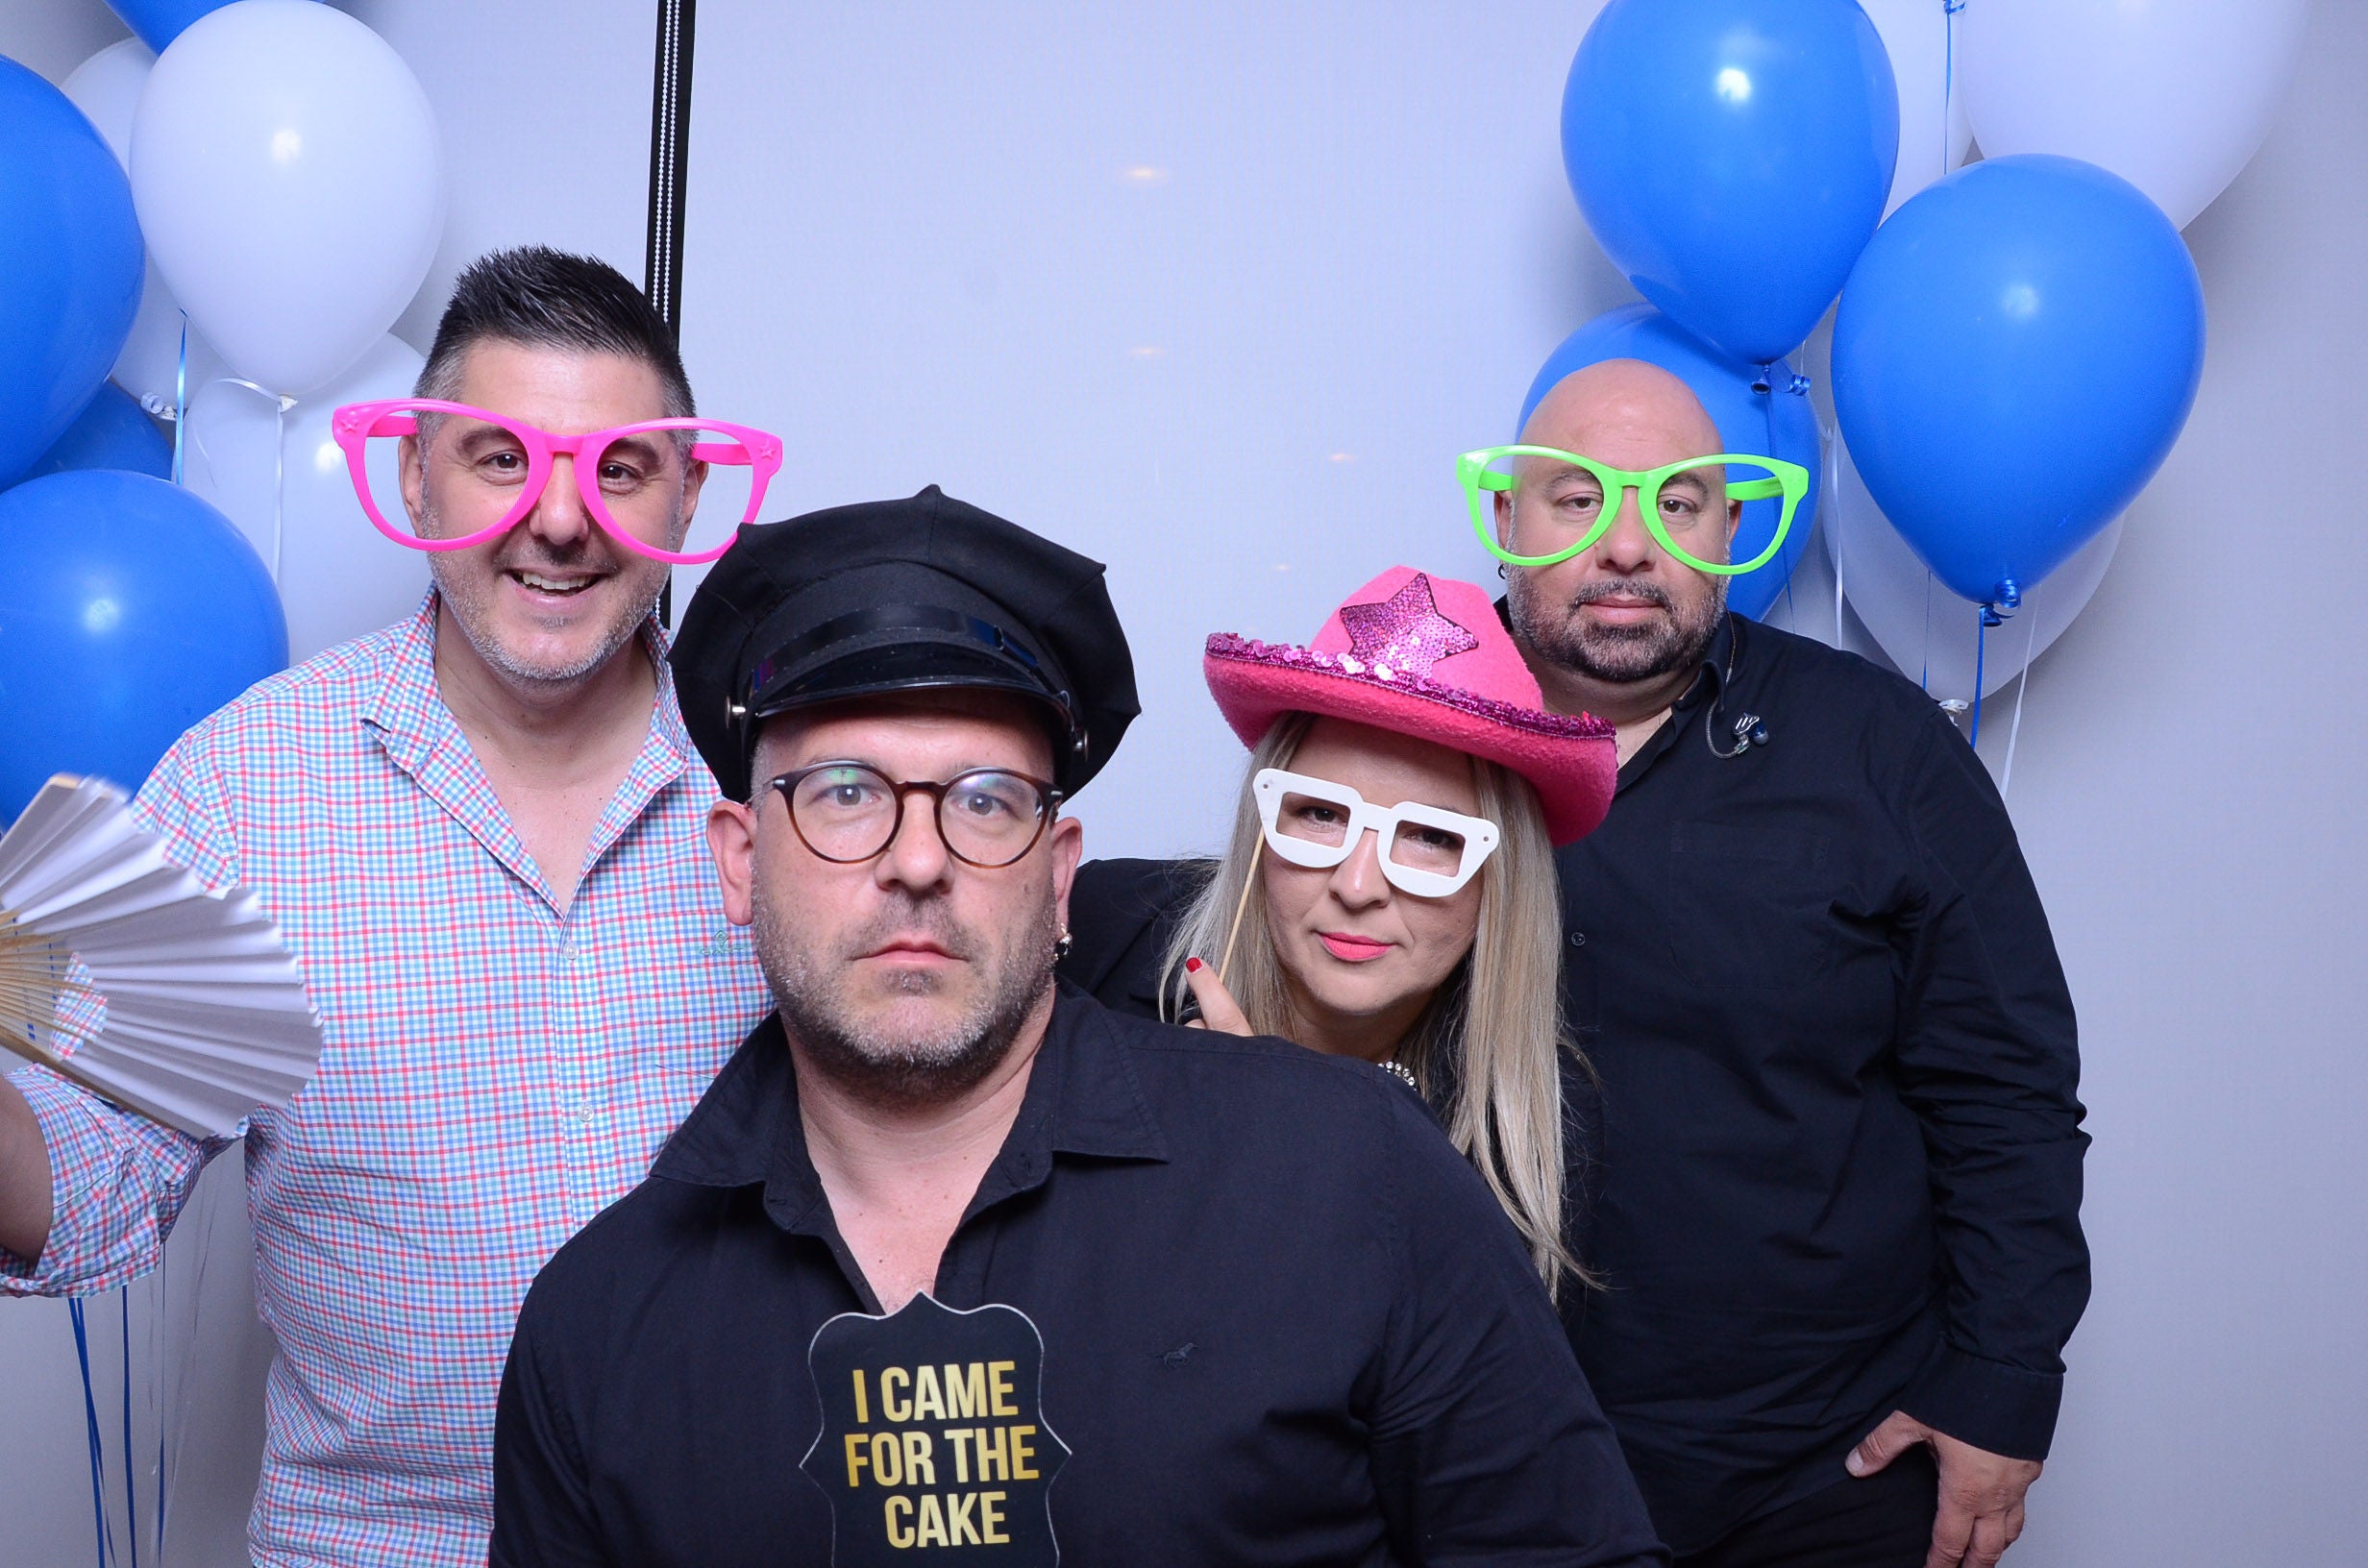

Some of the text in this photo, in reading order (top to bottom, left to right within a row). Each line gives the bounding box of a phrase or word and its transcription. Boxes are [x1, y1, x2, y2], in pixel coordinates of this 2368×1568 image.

[852, 1360, 1019, 1423] I CAME
[845, 1425, 1039, 1486] FOR THE
[884, 1491, 1010, 1548] CAKE
